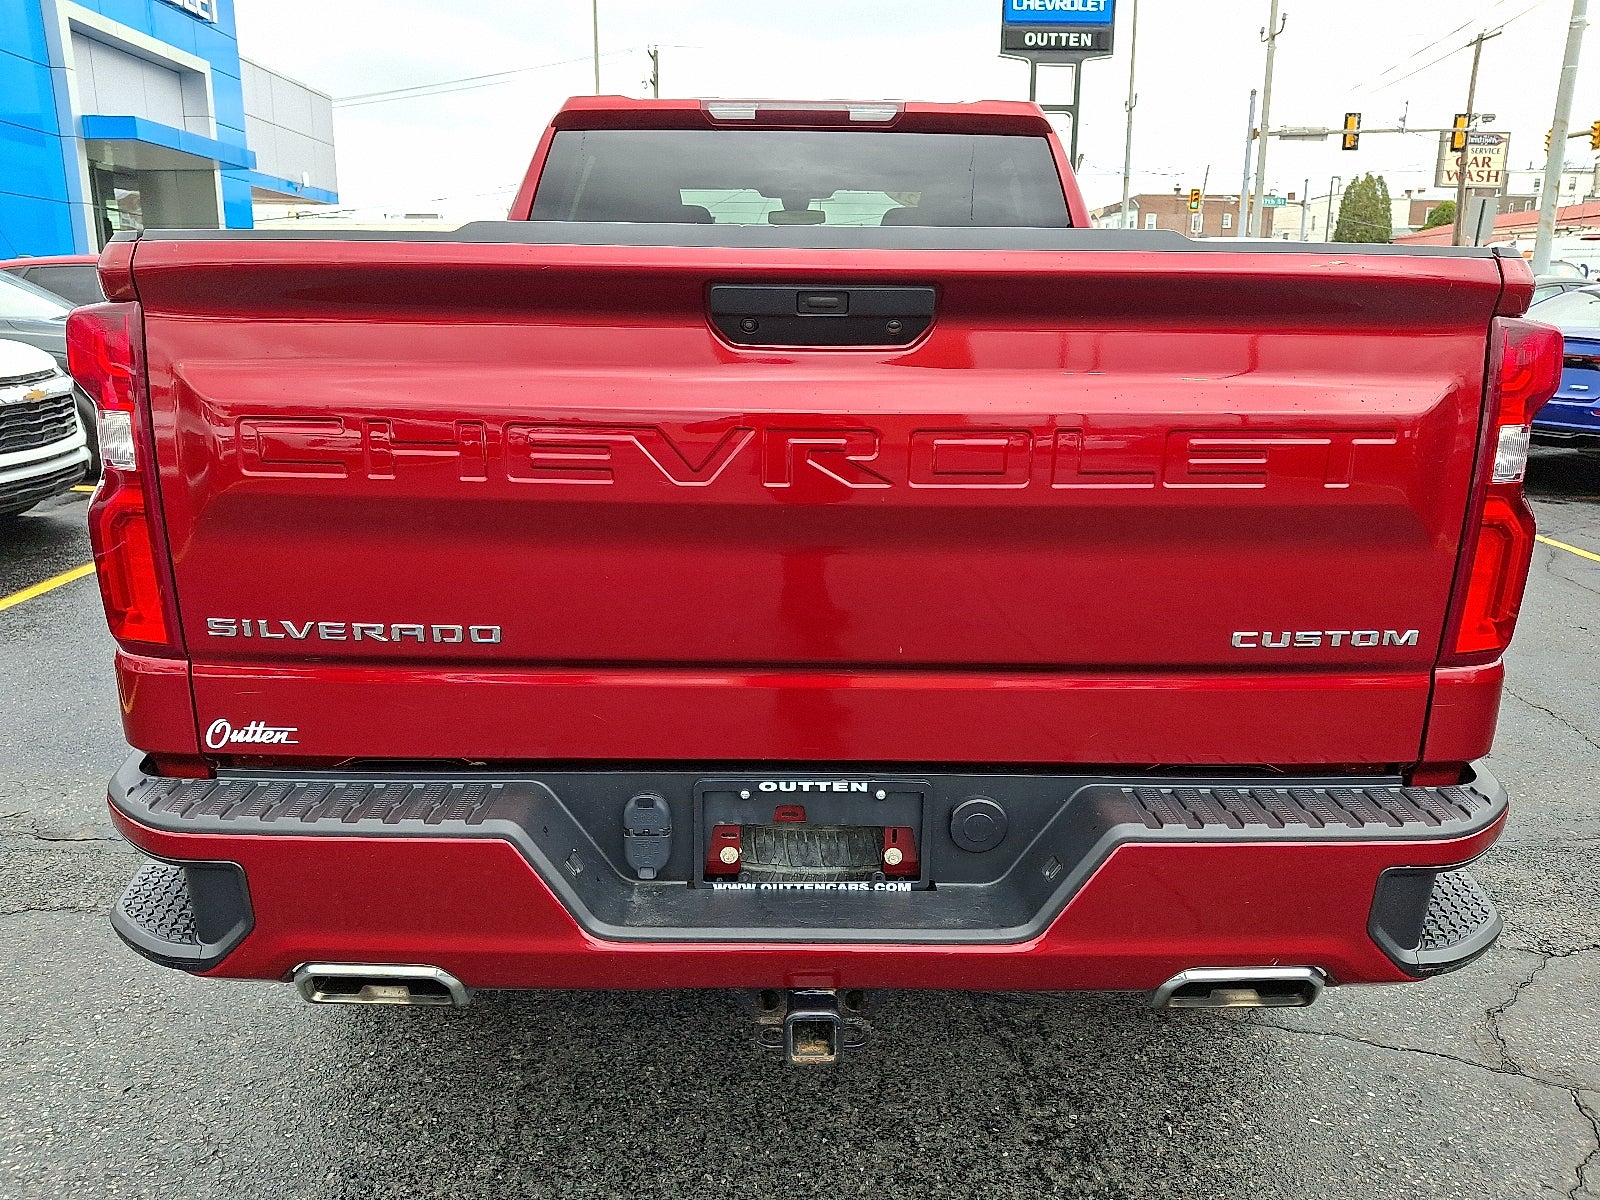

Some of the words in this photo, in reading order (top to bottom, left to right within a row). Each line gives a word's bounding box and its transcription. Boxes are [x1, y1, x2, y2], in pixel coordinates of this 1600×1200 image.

[1012, 0, 1106, 11] CHEVROLET
[1024, 32, 1093, 47] OUTTEN
[1470, 147, 1502, 155] SERVICE
[1455, 156, 1492, 168] CAR
[1446, 170, 1500, 183] WASH
[234, 414, 1398, 488] CHEVROLET
[206, 617, 502, 643] SILVERADO
[1231, 629, 1420, 648] CUSTOM
[205, 718, 299, 749] Outten
[758, 781, 868, 793] OUTTEN
[712, 882, 912, 892] WWWOUTTENCARS.COM
